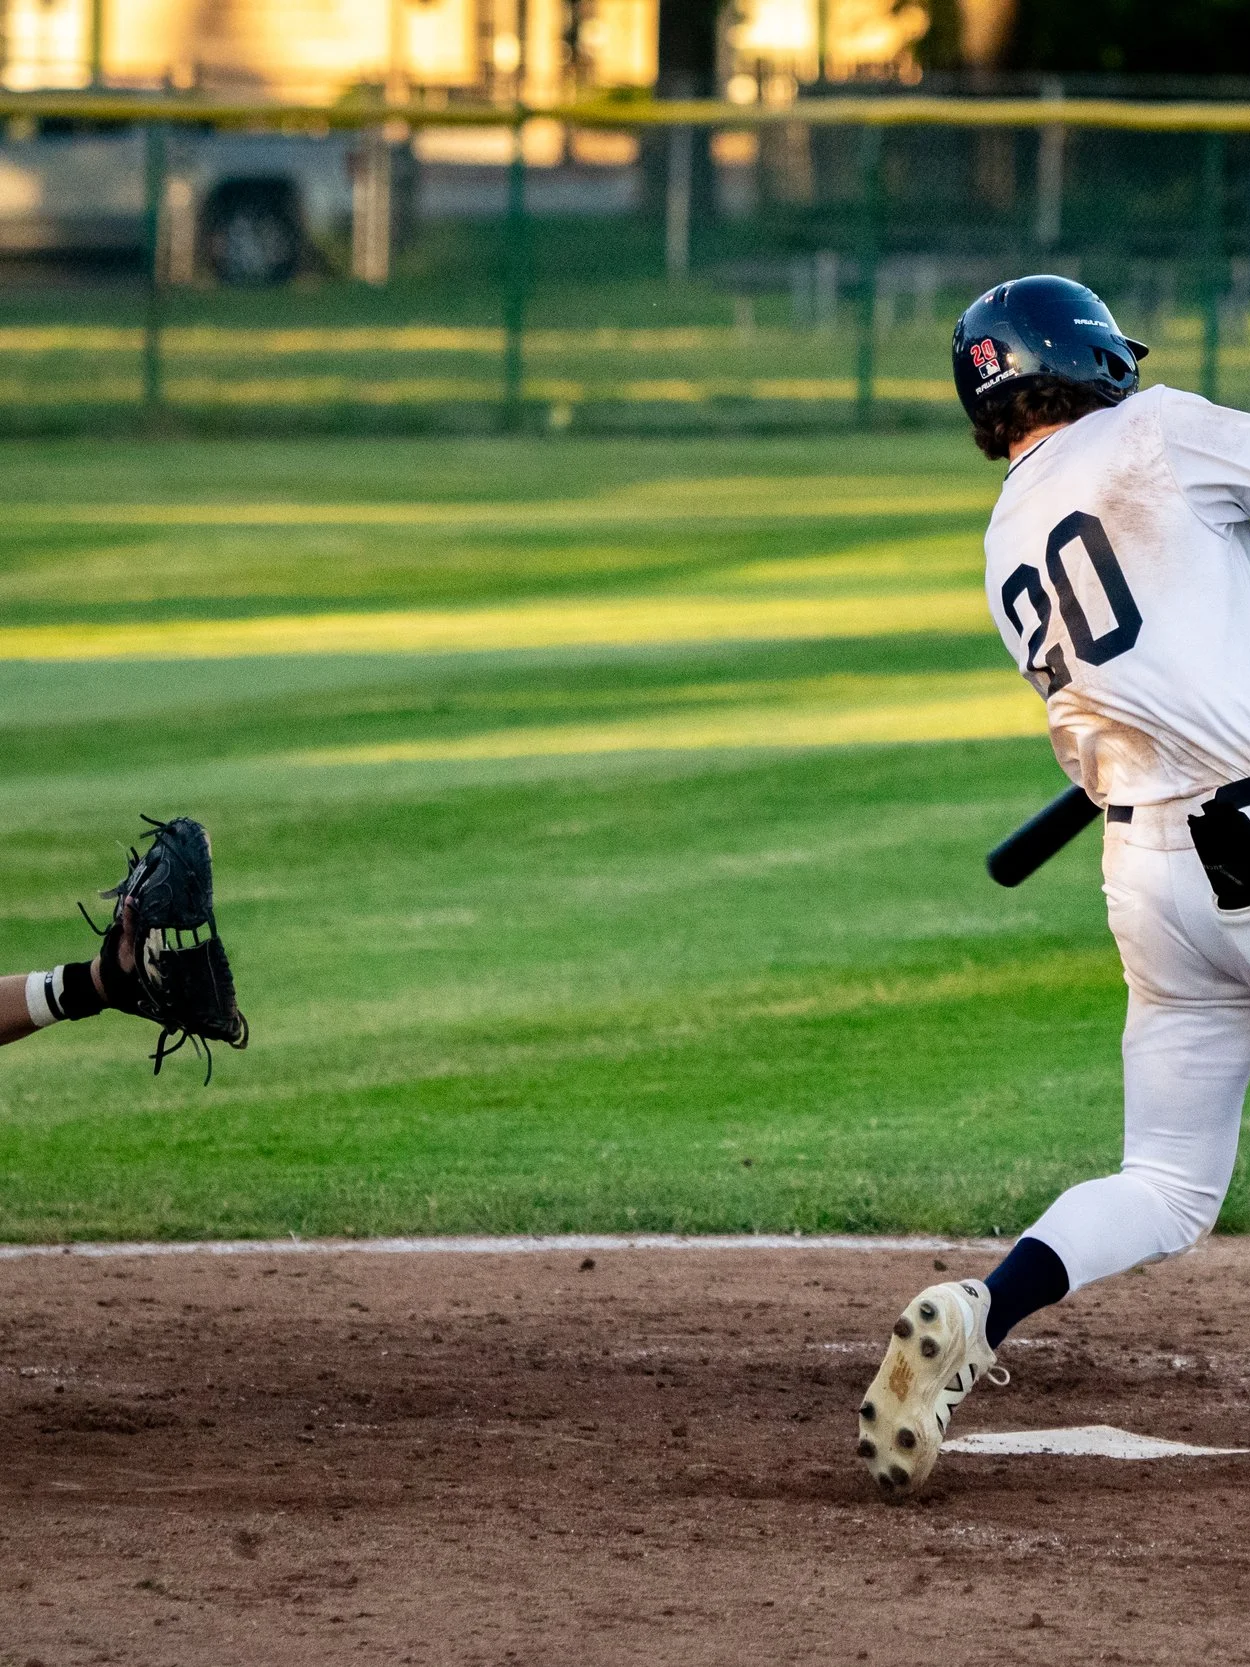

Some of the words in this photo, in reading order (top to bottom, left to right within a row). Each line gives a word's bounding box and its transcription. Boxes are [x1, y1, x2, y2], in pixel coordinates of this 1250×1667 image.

[970, 338, 996, 367] 20
[975, 367, 1016, 395] RAWLINGS
[1001, 510, 1143, 697] 20
